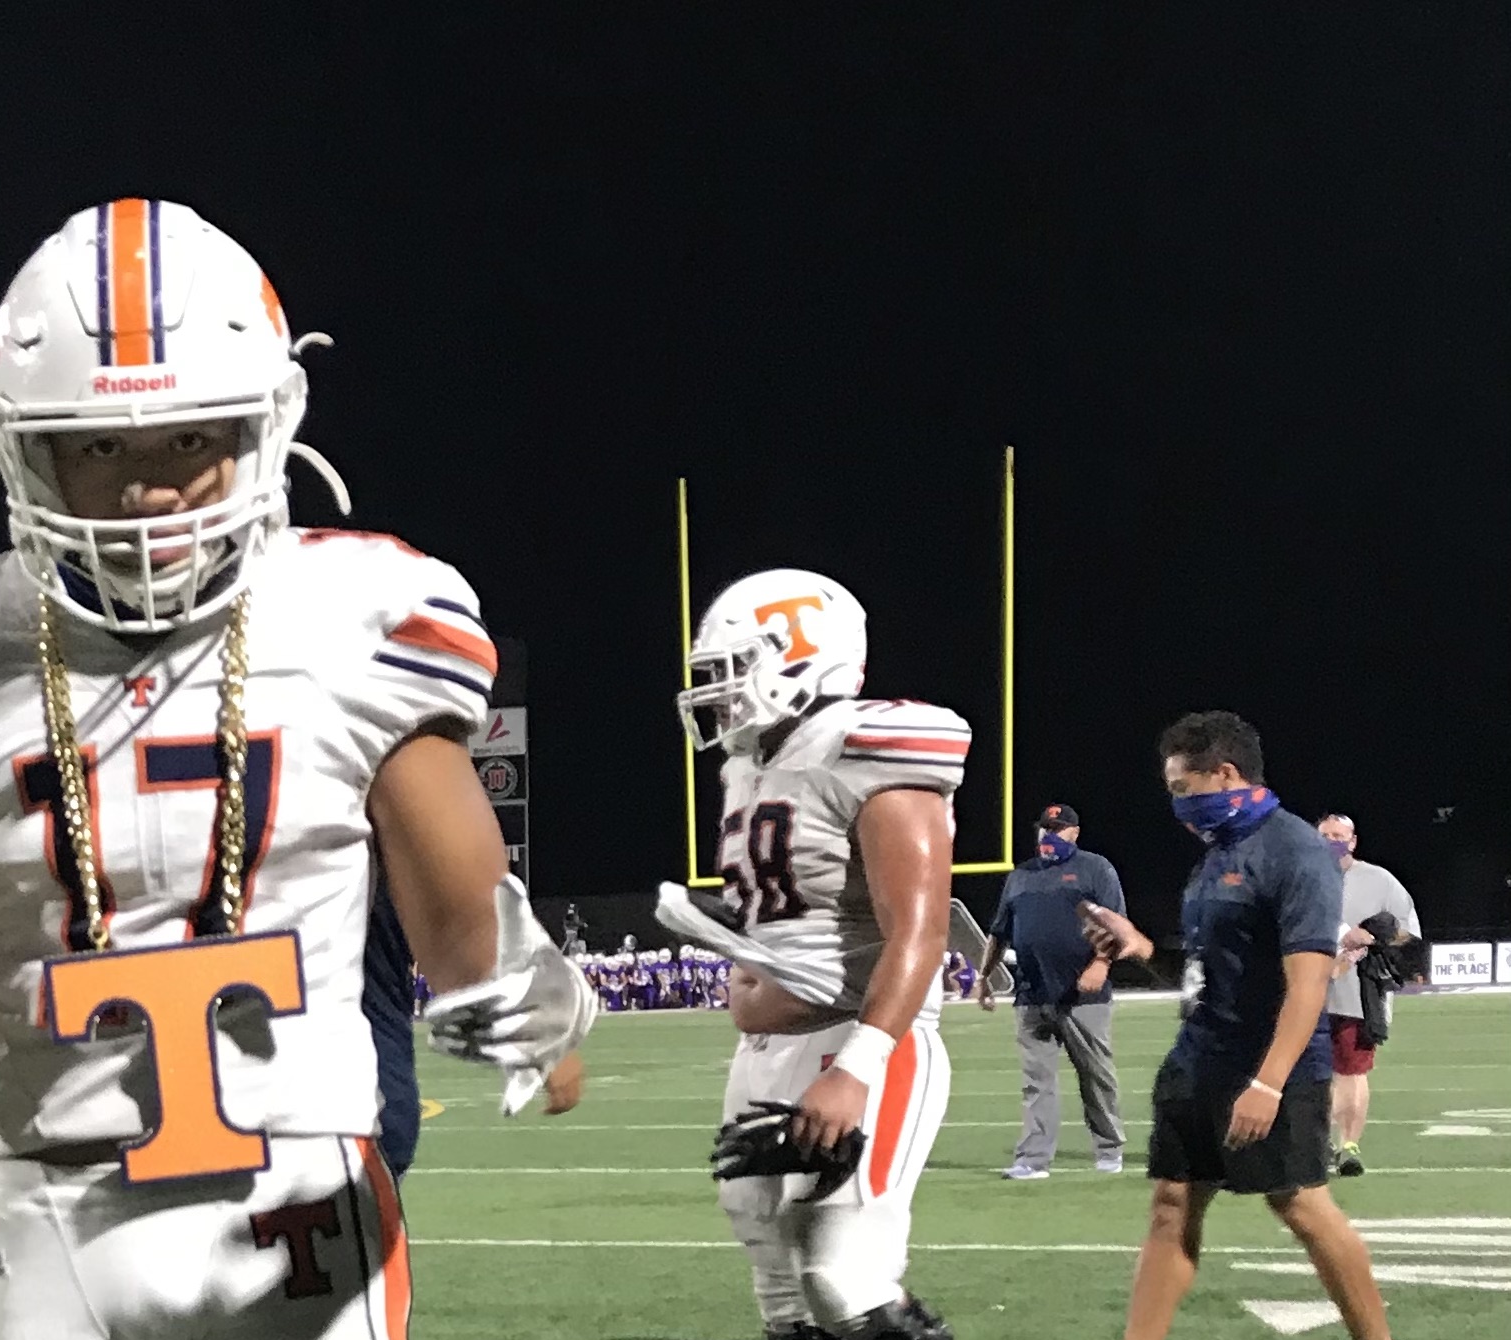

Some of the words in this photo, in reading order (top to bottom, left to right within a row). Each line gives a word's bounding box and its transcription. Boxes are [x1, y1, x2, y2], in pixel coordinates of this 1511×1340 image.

[753, 595, 824, 663] T
[123, 675, 157, 707] T
[12, 724, 283, 953] 17
[714, 799, 811, 937] 58
[1435, 964, 1453, 976] THE
[1457, 962, 1490, 975] PLACE
[1449, 953, 1466, 962] THIS
[1468, 953, 1476, 962] IS
[44, 928, 307, 1190] T
[249, 1196, 342, 1299] T
